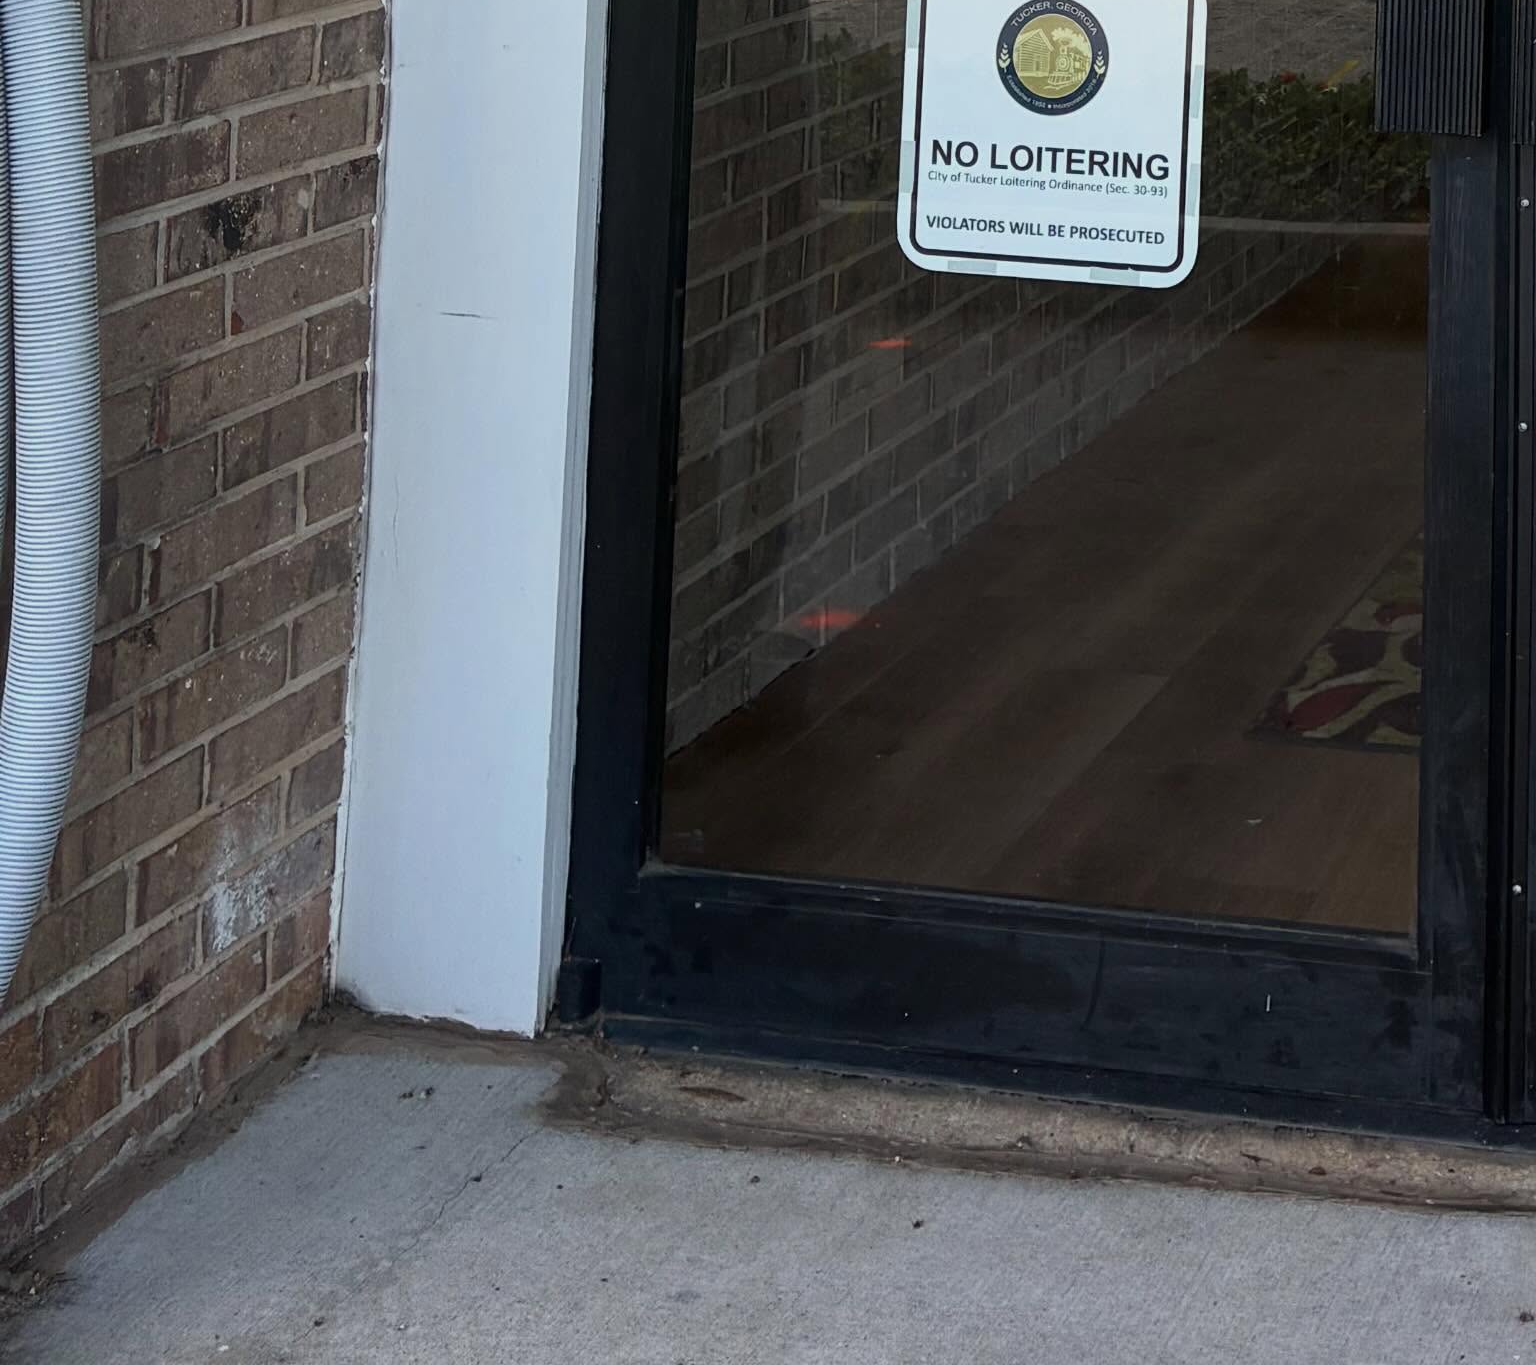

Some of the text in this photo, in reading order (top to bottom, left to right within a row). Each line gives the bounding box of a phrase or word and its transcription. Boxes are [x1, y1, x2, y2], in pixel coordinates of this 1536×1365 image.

[1055, 1, 1098, 36] GEORGIA
[931, 139, 1170, 181] NO LOITERING
[927, 170, 1168, 199] City of Tucker Loitering Ordinance (Sec. 30-93)
[926, 215, 1165, 245] VIOLATORS WILL BE PROSECUTED
